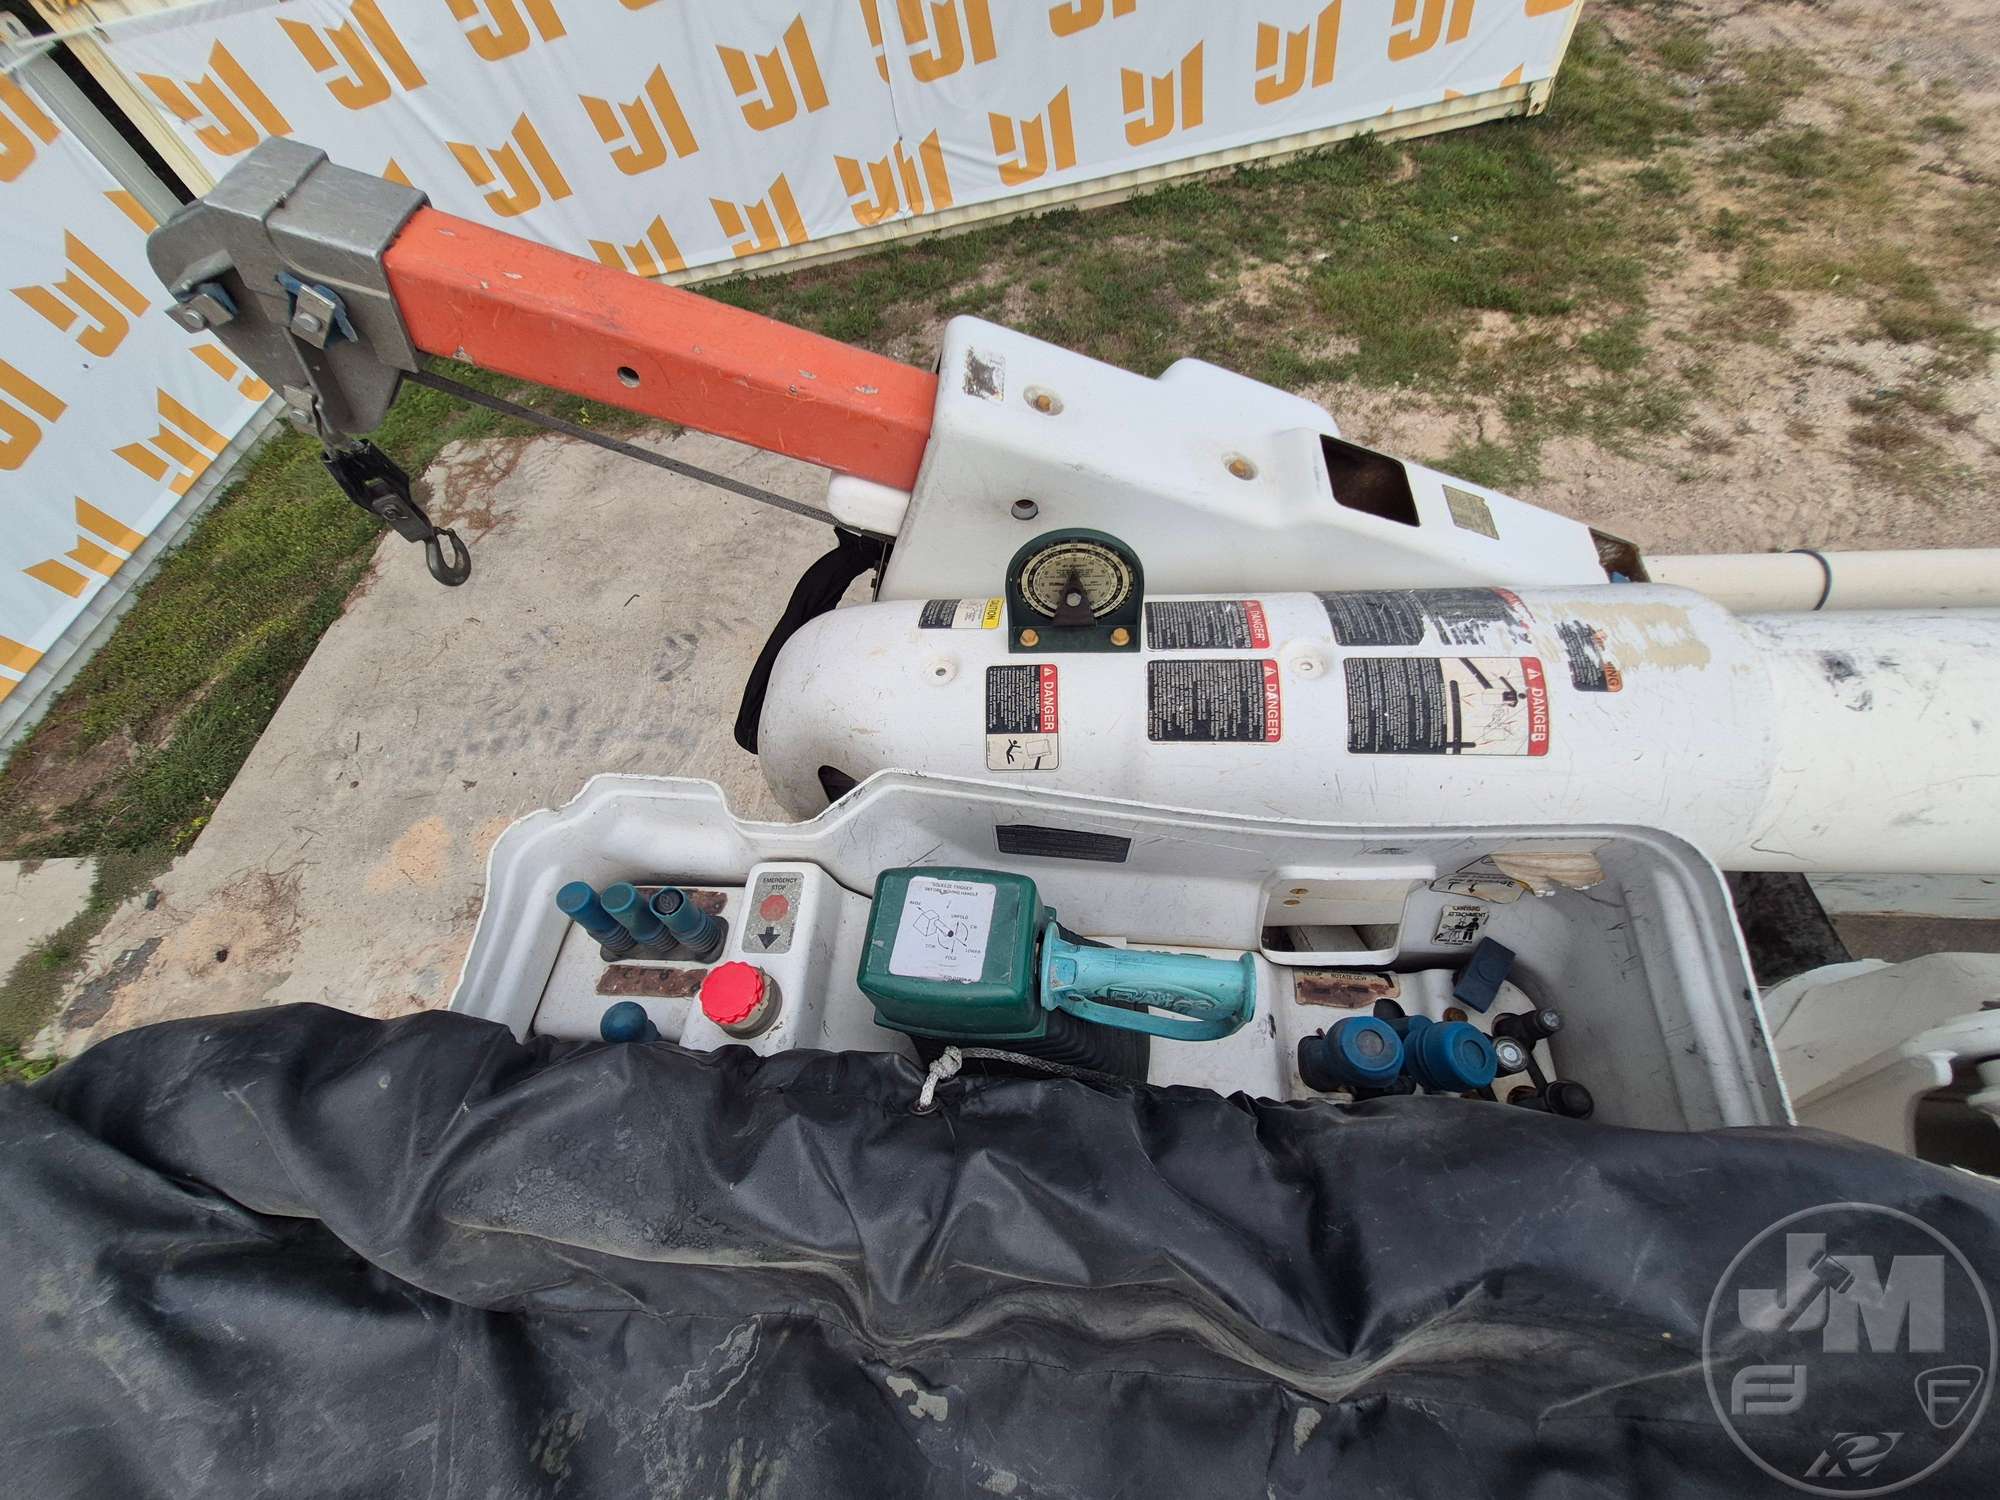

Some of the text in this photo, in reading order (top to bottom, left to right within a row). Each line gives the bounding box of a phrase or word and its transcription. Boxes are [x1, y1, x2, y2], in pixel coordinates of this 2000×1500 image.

[1251, 611, 1266, 640] DANGER
[1044, 682, 1055, 730] DANGER
[1266, 684, 1278, 736] DANGER
[1531, 688, 1546, 742] DANGER
